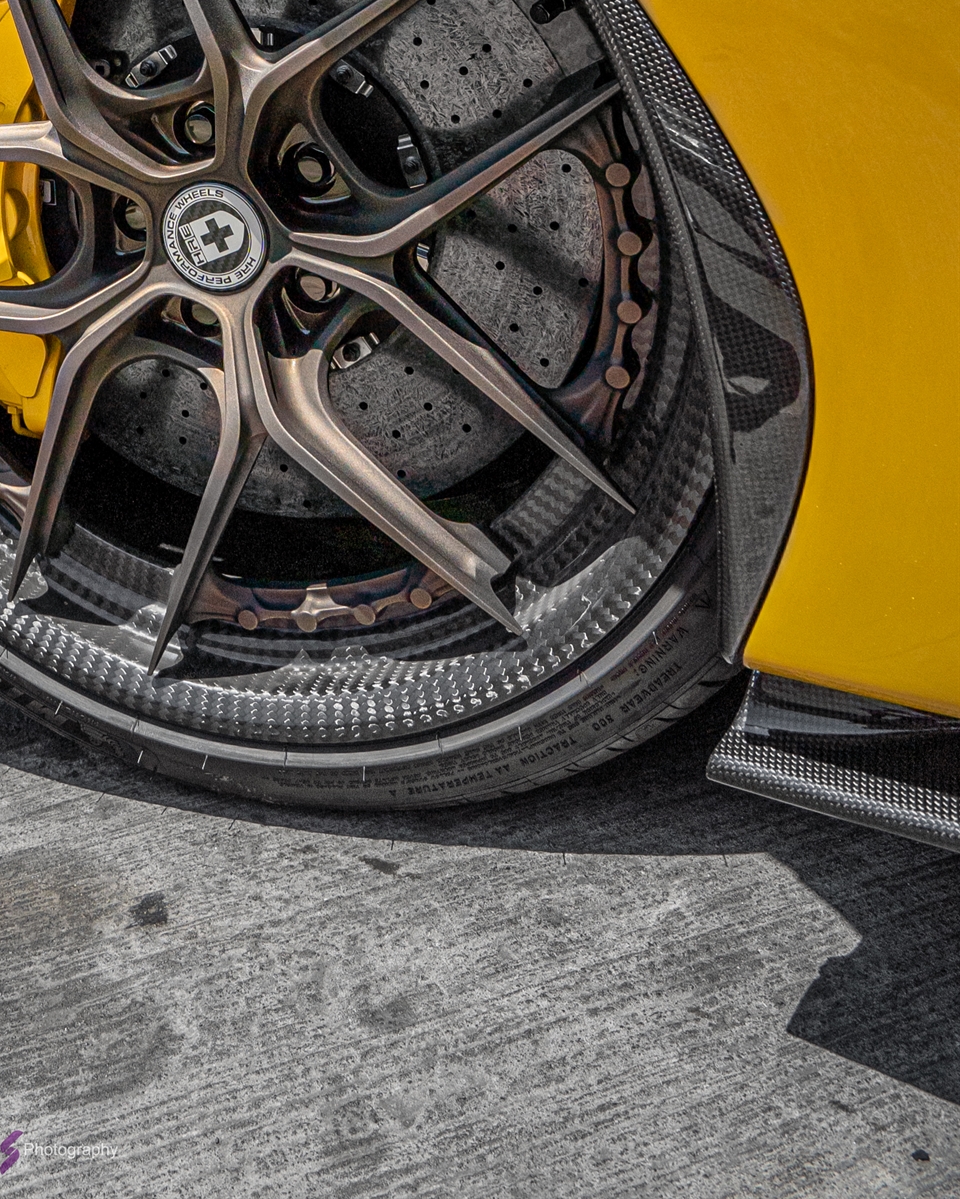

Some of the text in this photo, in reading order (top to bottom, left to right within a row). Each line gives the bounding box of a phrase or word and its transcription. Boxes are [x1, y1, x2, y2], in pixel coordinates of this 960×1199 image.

[166, 188, 257, 285] HRE PERFORMANCE WHEELS
[180, 224, 206, 266] HRE
[619, 662, 682, 713] TREADWEAR
[495, 764, 510, 774] AA
[519, 736, 577, 766] TRACTION
[408, 770, 494, 795] TEMPERATURE
